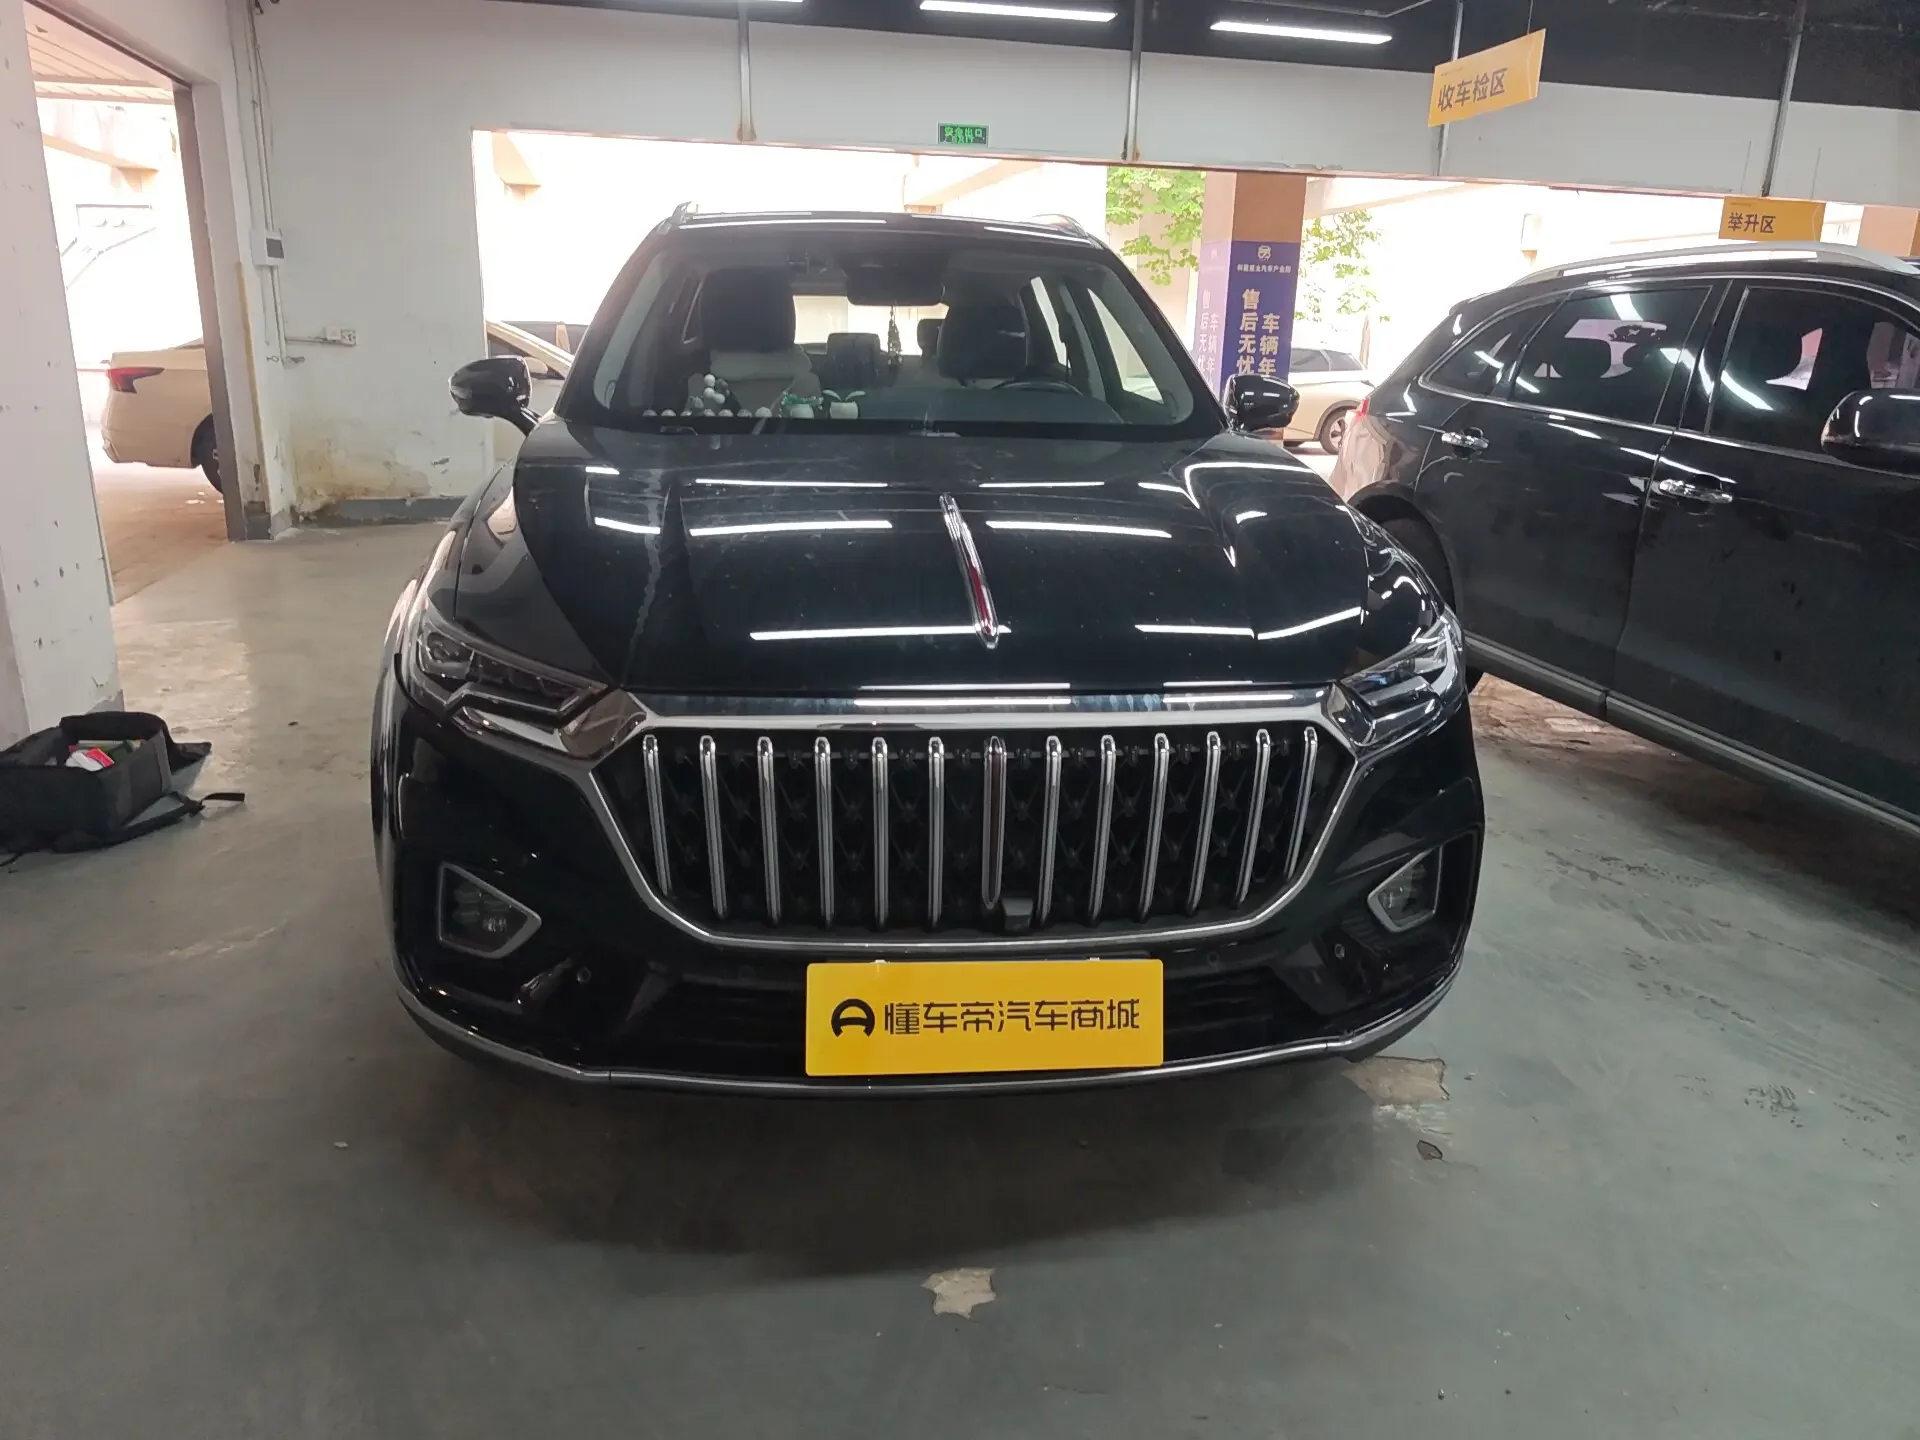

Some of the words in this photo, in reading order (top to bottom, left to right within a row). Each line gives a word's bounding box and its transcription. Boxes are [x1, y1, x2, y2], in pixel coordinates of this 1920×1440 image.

[1438, 67, 1508, 112] 收车检区
[1728, 212, 1776, 234] 举升区
[1236, 288, 1260, 376] 售后无忧
[1257, 312, 1280, 376] 车辆年
[884, 998, 1140, 1035] 懂车帝汽车商城
